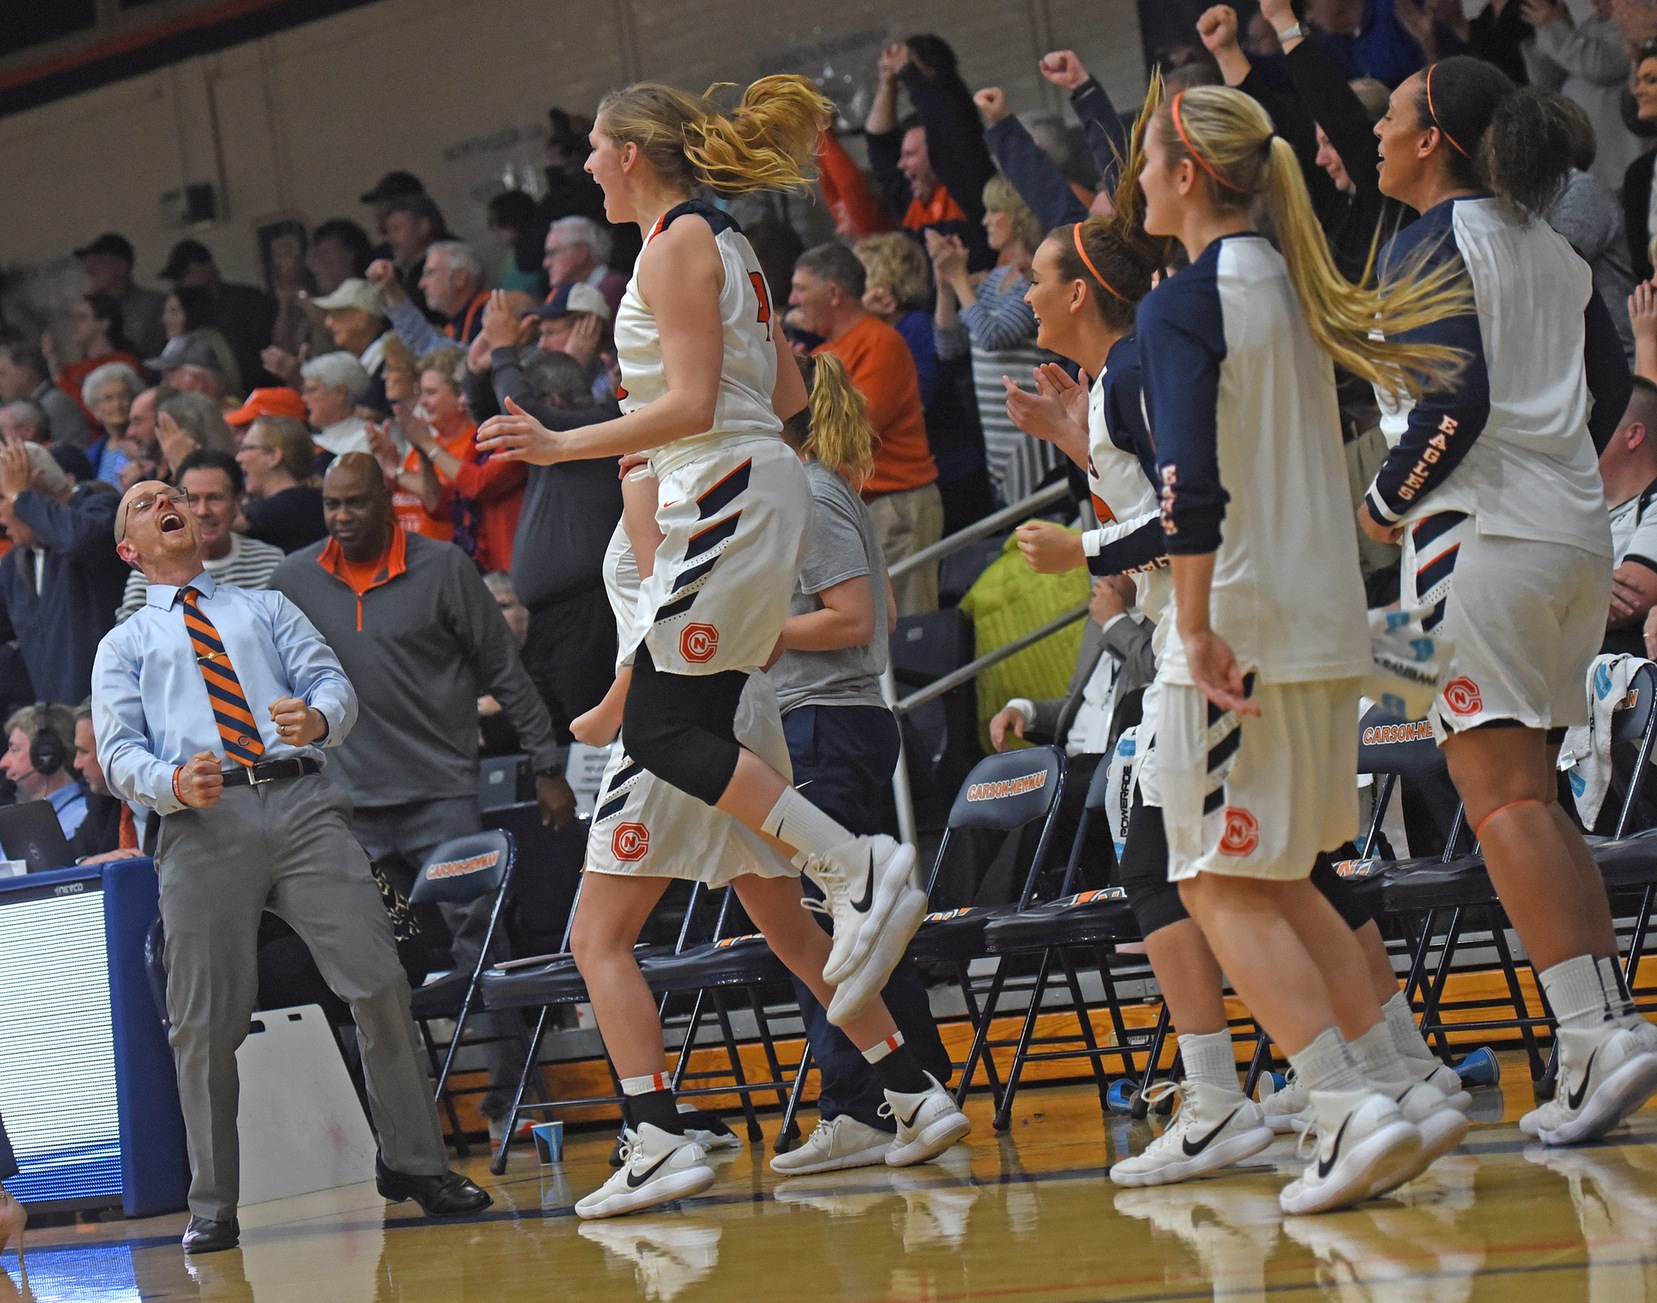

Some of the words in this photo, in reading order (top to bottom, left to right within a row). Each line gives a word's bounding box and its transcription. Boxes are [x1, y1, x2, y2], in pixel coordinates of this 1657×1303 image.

[1397, 413, 1459, 501] EAGLES
[1362, 720, 1435, 746] CARSON-NE
[967, 769, 1048, 802] CARSON-NEWMAN
[1120, 763, 1133, 838] POWERADE
[1454, 1059, 1489, 1073] OWERADE
